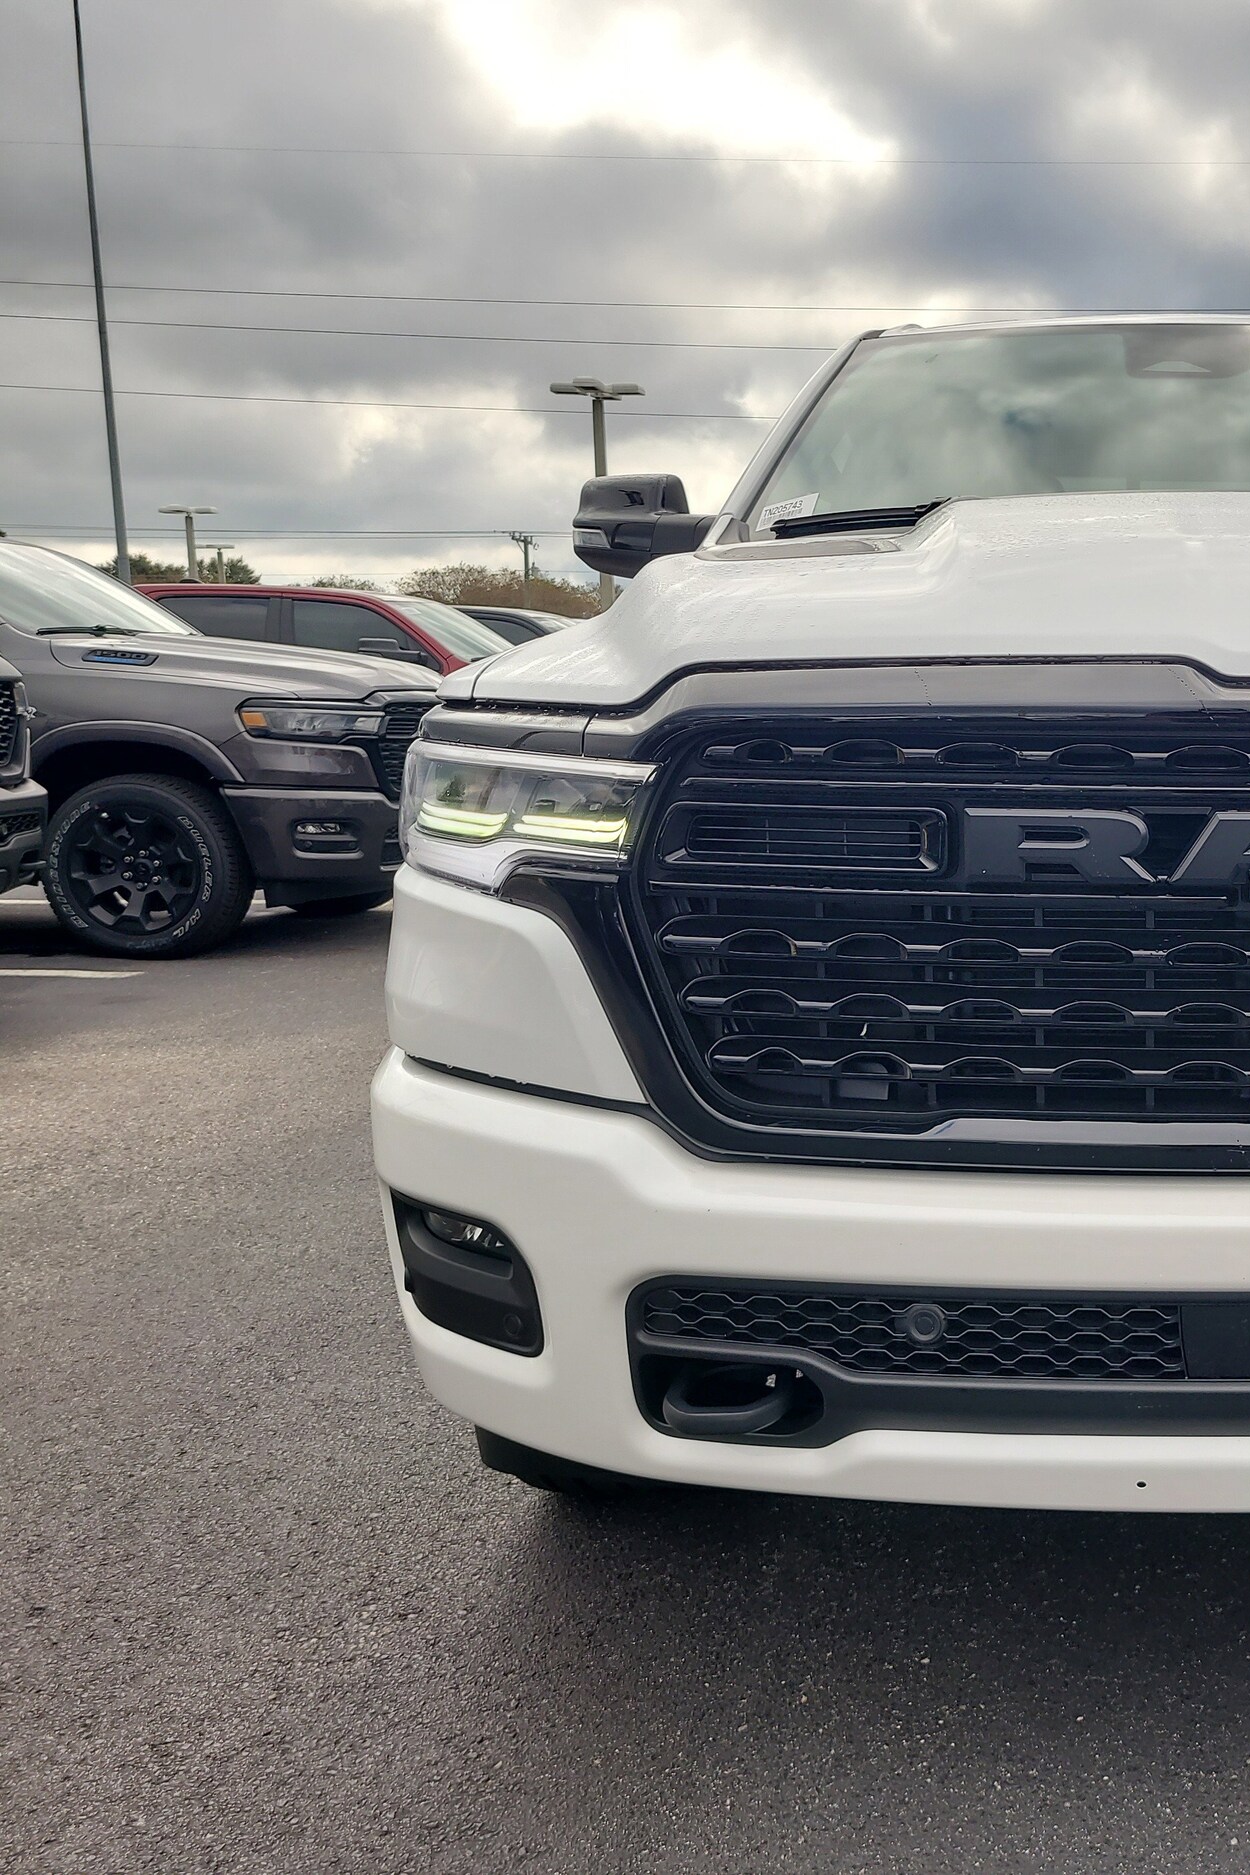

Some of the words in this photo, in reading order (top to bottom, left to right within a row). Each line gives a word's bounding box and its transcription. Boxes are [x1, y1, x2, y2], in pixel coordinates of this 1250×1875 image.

[763, 500, 804, 517] TN205743
[95, 650, 146, 659] 1500
[50, 801, 91, 928] BRIDGESTONE
[177, 816, 213, 902] DUELER
